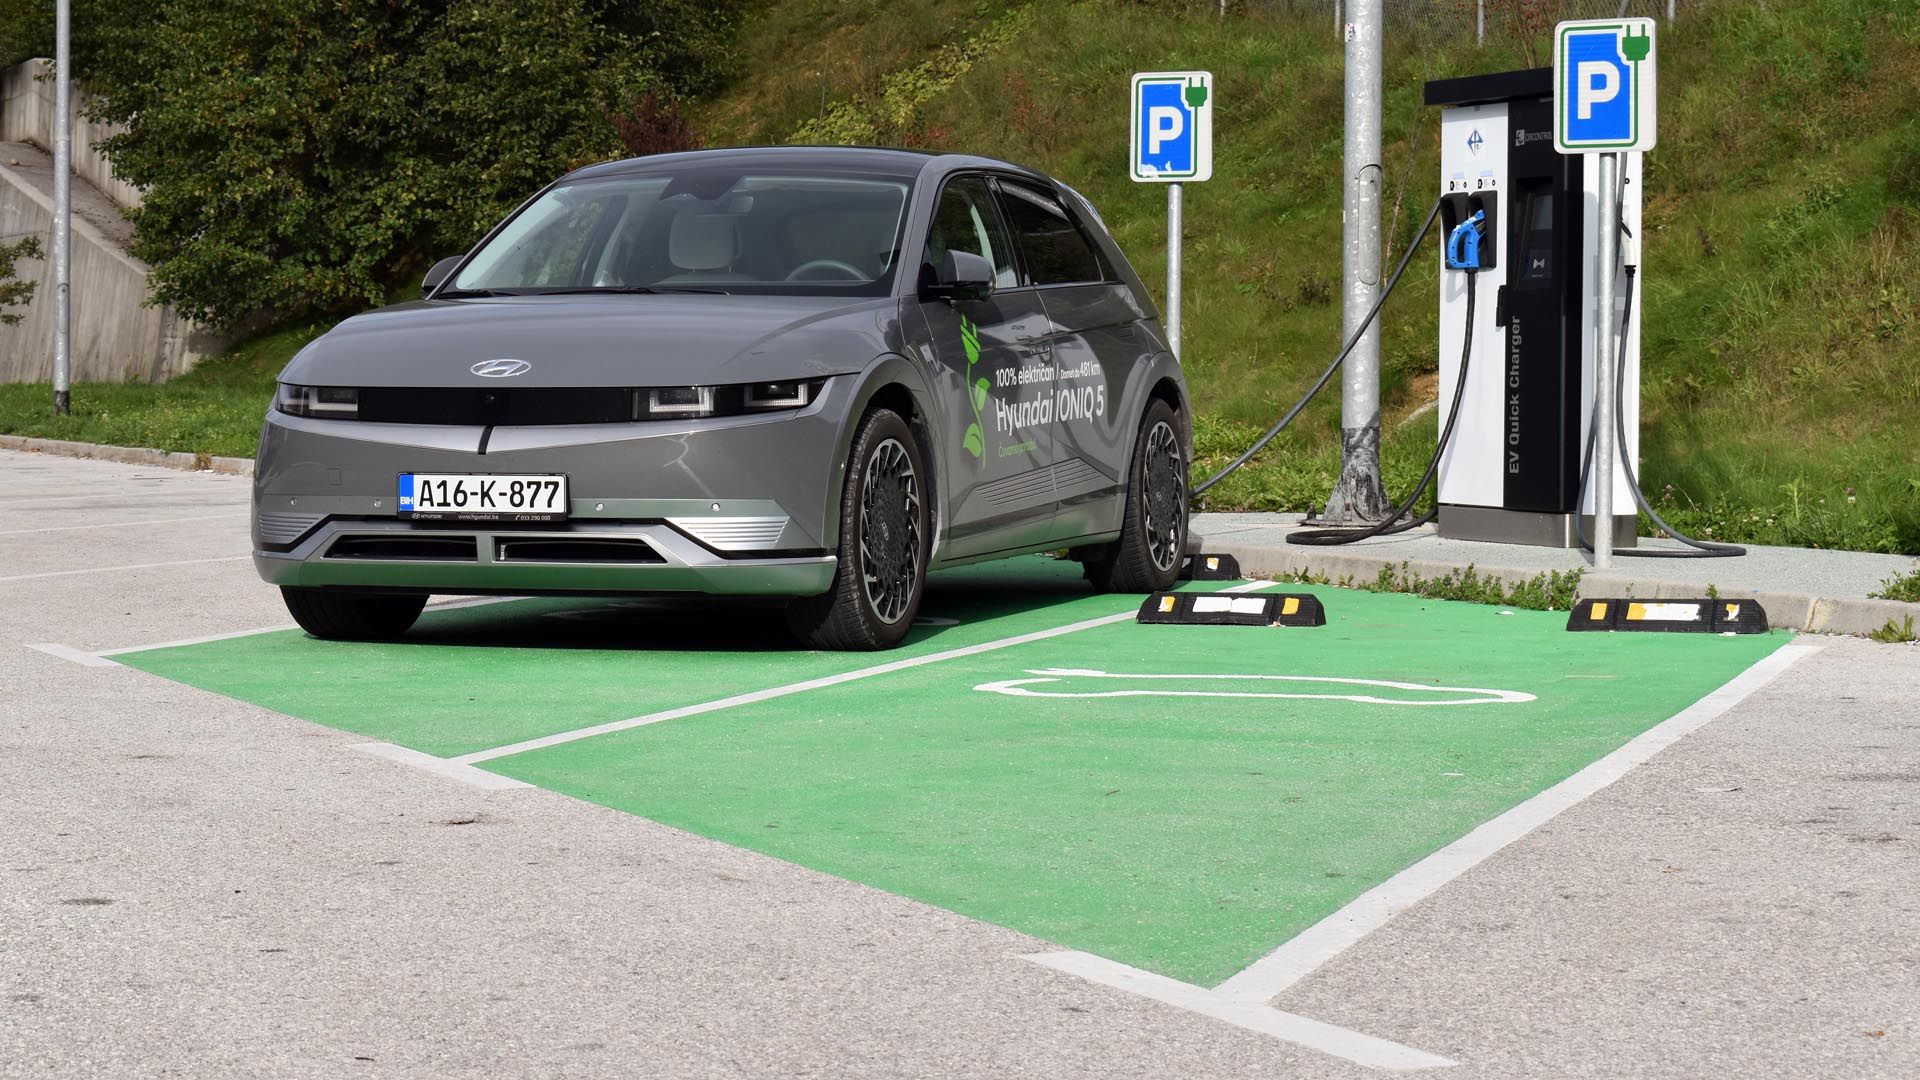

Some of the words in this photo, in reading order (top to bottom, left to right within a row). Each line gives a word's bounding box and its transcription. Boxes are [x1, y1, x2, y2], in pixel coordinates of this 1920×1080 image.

[1578, 61, 1620, 120] P
[1149, 106, 1184, 154] P
[996, 368, 1017, 387] 100%
[1018, 363, 1054, 384] električan
[1080, 362, 1091, 377] 481
[1091, 361, 1101, 375] km
[1509, 316, 1522, 388] Charger
[996, 388, 1054, 436] Hyundai
[1055, 386, 1094, 424] IONIQ
[1096, 385, 1104, 416] 5
[1509, 393, 1520, 446] Quick
[1509, 451, 1519, 474] EV
[400, 496, 414, 505] BIH
[419, 480, 560, 508] A16-K-877
